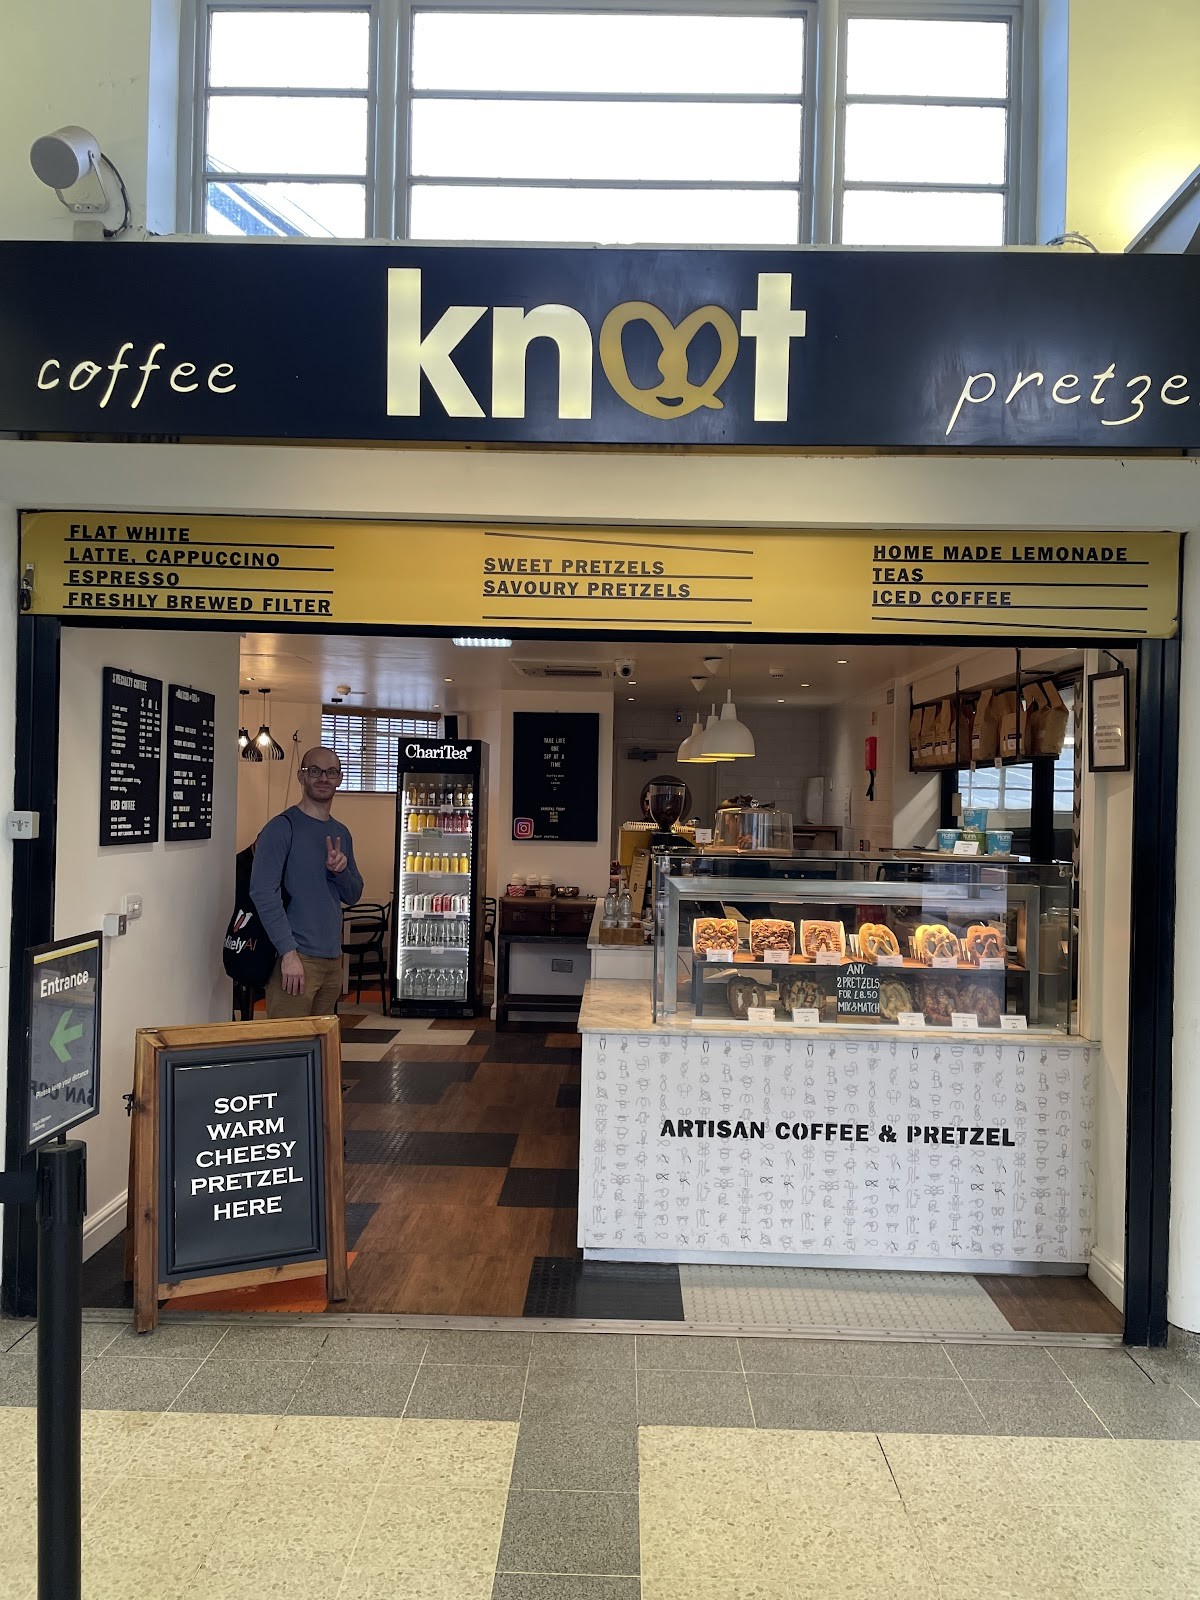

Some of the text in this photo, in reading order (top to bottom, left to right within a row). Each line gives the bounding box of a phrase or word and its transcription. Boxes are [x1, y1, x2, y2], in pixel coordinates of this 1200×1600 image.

[37, 342, 237, 408] coffee
[945, 363, 1200, 436] pretze
[70, 524, 190, 542] FLAT WHITE
[145, 549, 280, 567] CAPPUCCINO
[873, 545, 1128, 562] HOME MADE LEMONADE
[484, 557, 665, 575] SWEET PRETZELS
[872, 568, 924, 582] TEAS
[69, 569, 180, 587] ESPRESSO
[483, 580, 691, 598] SAVOURY PRETZELS
[872, 590, 1012, 606] ICED COFFEE
[68, 592, 331, 613] FRESHLY BREWED FILTER
[405, 744, 468, 760] ChariTea
[846, 964, 866, 975] ANY
[40, 970, 89, 998] Entrance
[838, 990, 878, 1000] FOR £8.50
[214, 1092, 278, 1114] SOFT
[206, 1116, 285, 1141] WARM
[660, 1119, 1016, 1147] ARTISAN COFFEE & PRETZEL
[195, 1140, 297, 1168] CHEESY
[190, 1166, 304, 1196] PRETZEL
[213, 1195, 282, 1221] HERE
